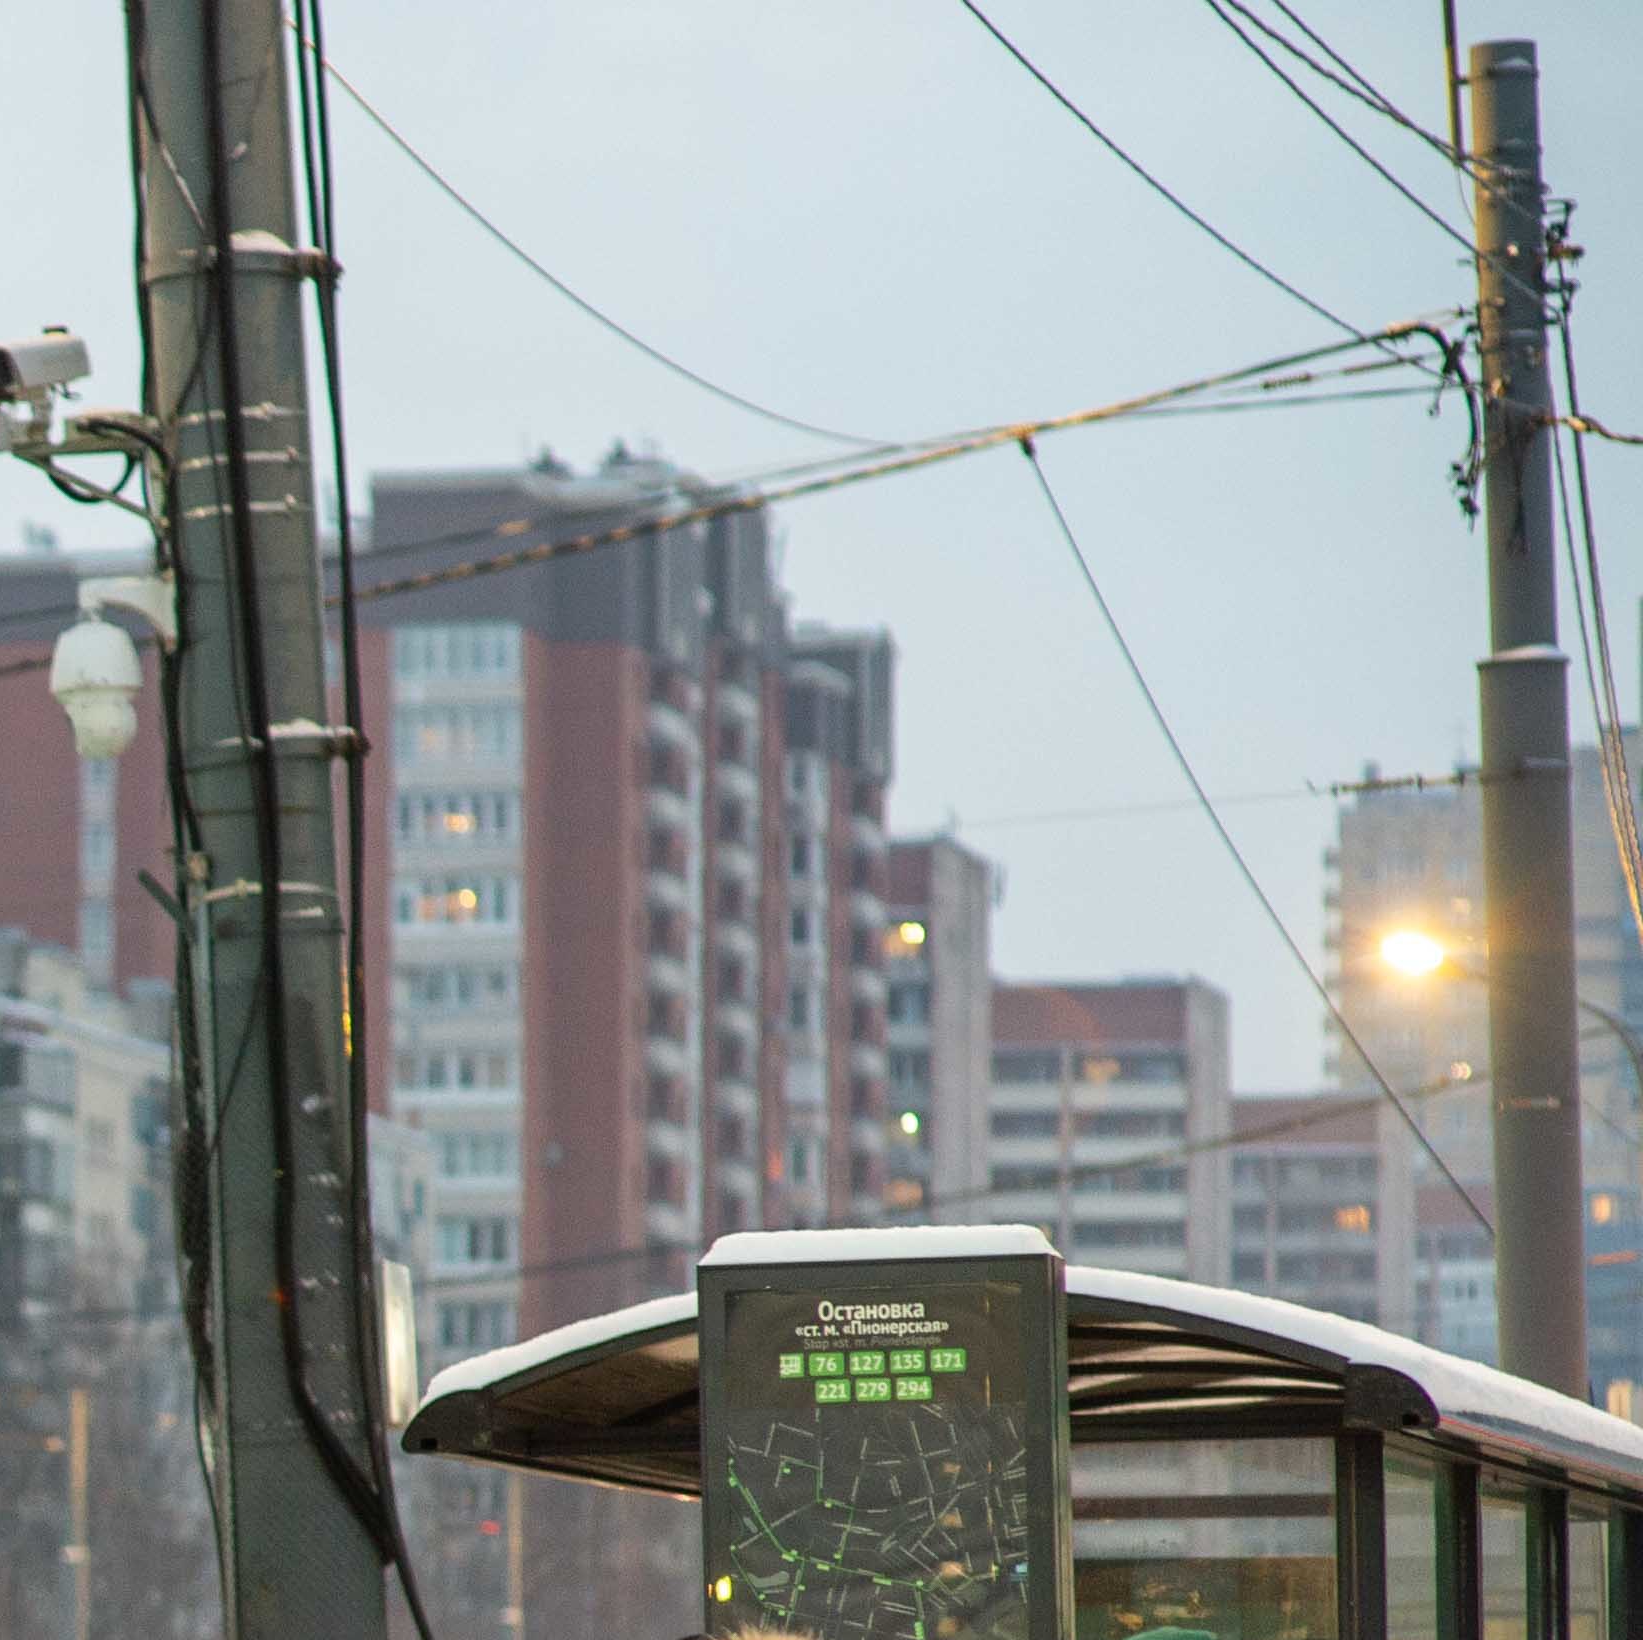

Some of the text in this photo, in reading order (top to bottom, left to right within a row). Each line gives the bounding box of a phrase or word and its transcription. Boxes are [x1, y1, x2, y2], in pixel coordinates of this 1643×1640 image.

[818, 1301, 925, 1321] Остановка
[816, 1352, 963, 1372] 76 127 135 171
[818, 1381, 928, 1400] 221 279 294
